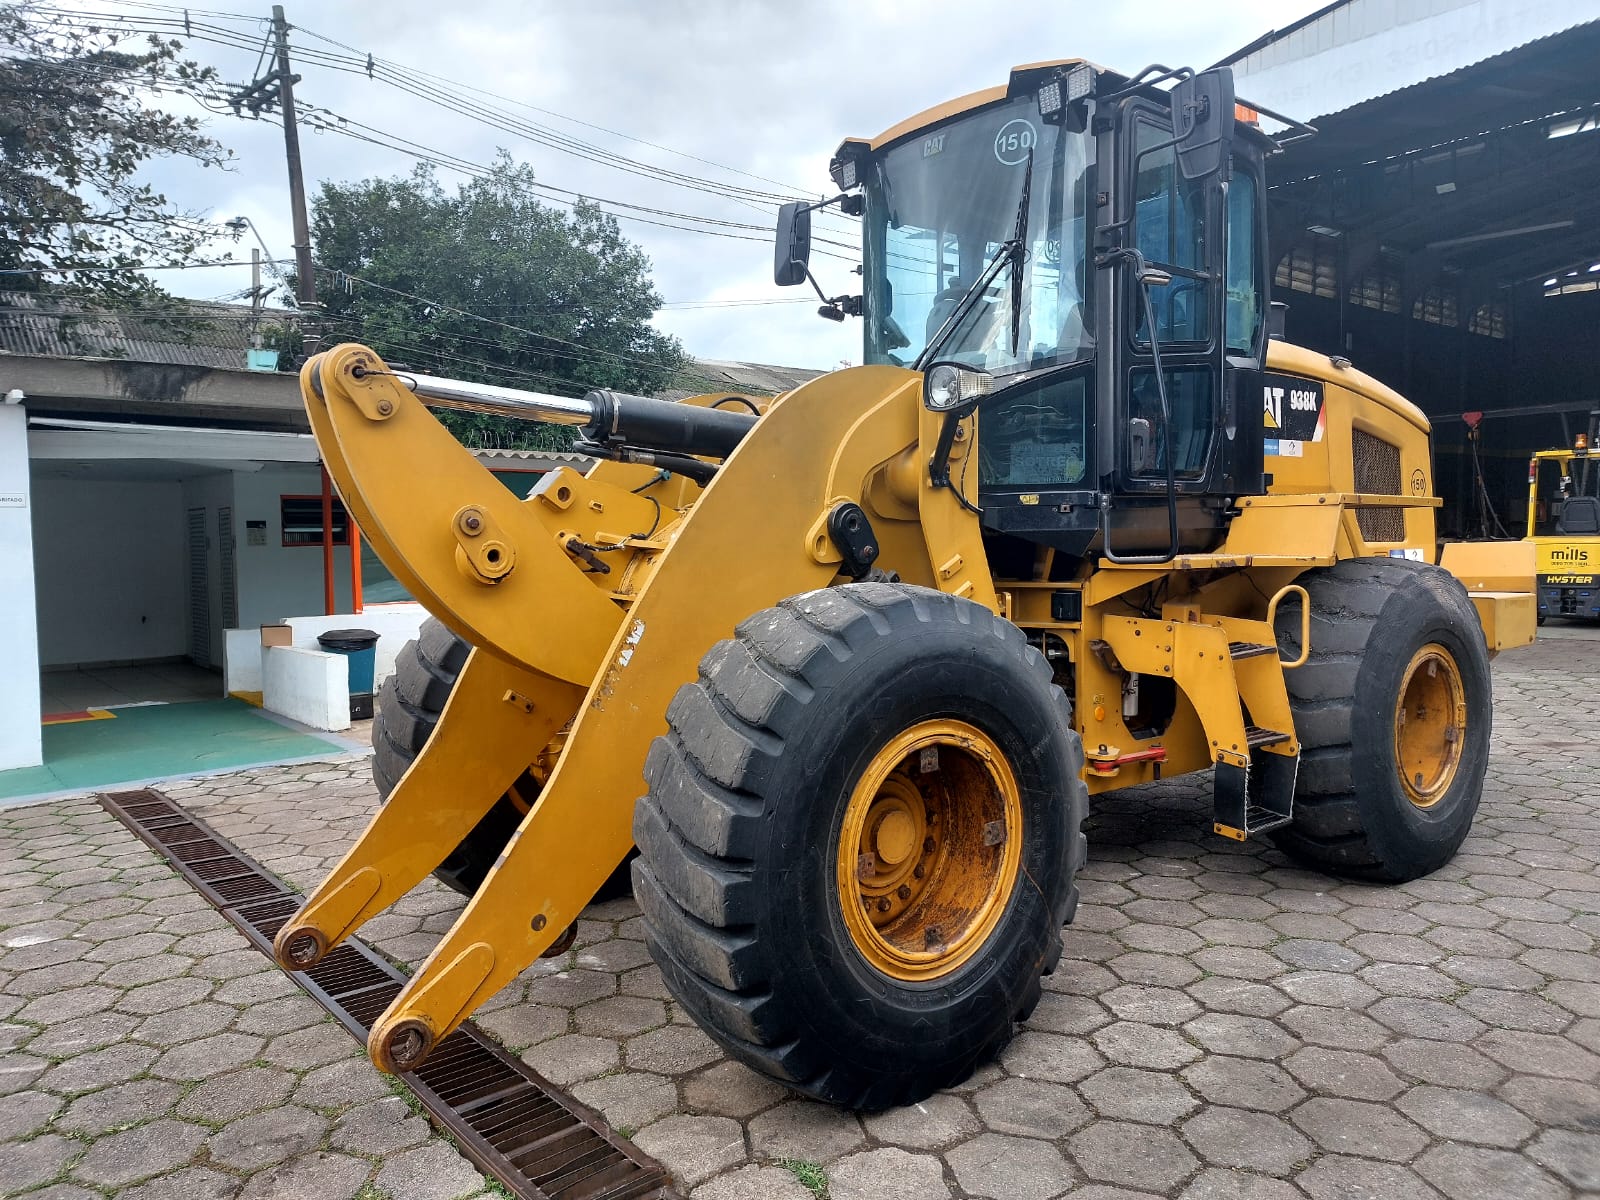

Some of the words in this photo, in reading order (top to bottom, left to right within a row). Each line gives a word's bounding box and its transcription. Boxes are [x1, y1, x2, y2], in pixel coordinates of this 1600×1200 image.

[923, 134, 946, 157] CAT
[998, 131, 1031, 153] 150
[1264, 387, 1285, 429] AT
[1290, 390, 1317, 411] 938K
[1412, 478, 1425, 491] 150
[1551, 547, 1588, 560] mills
[1546, 575, 1593, 584] HYSTER
